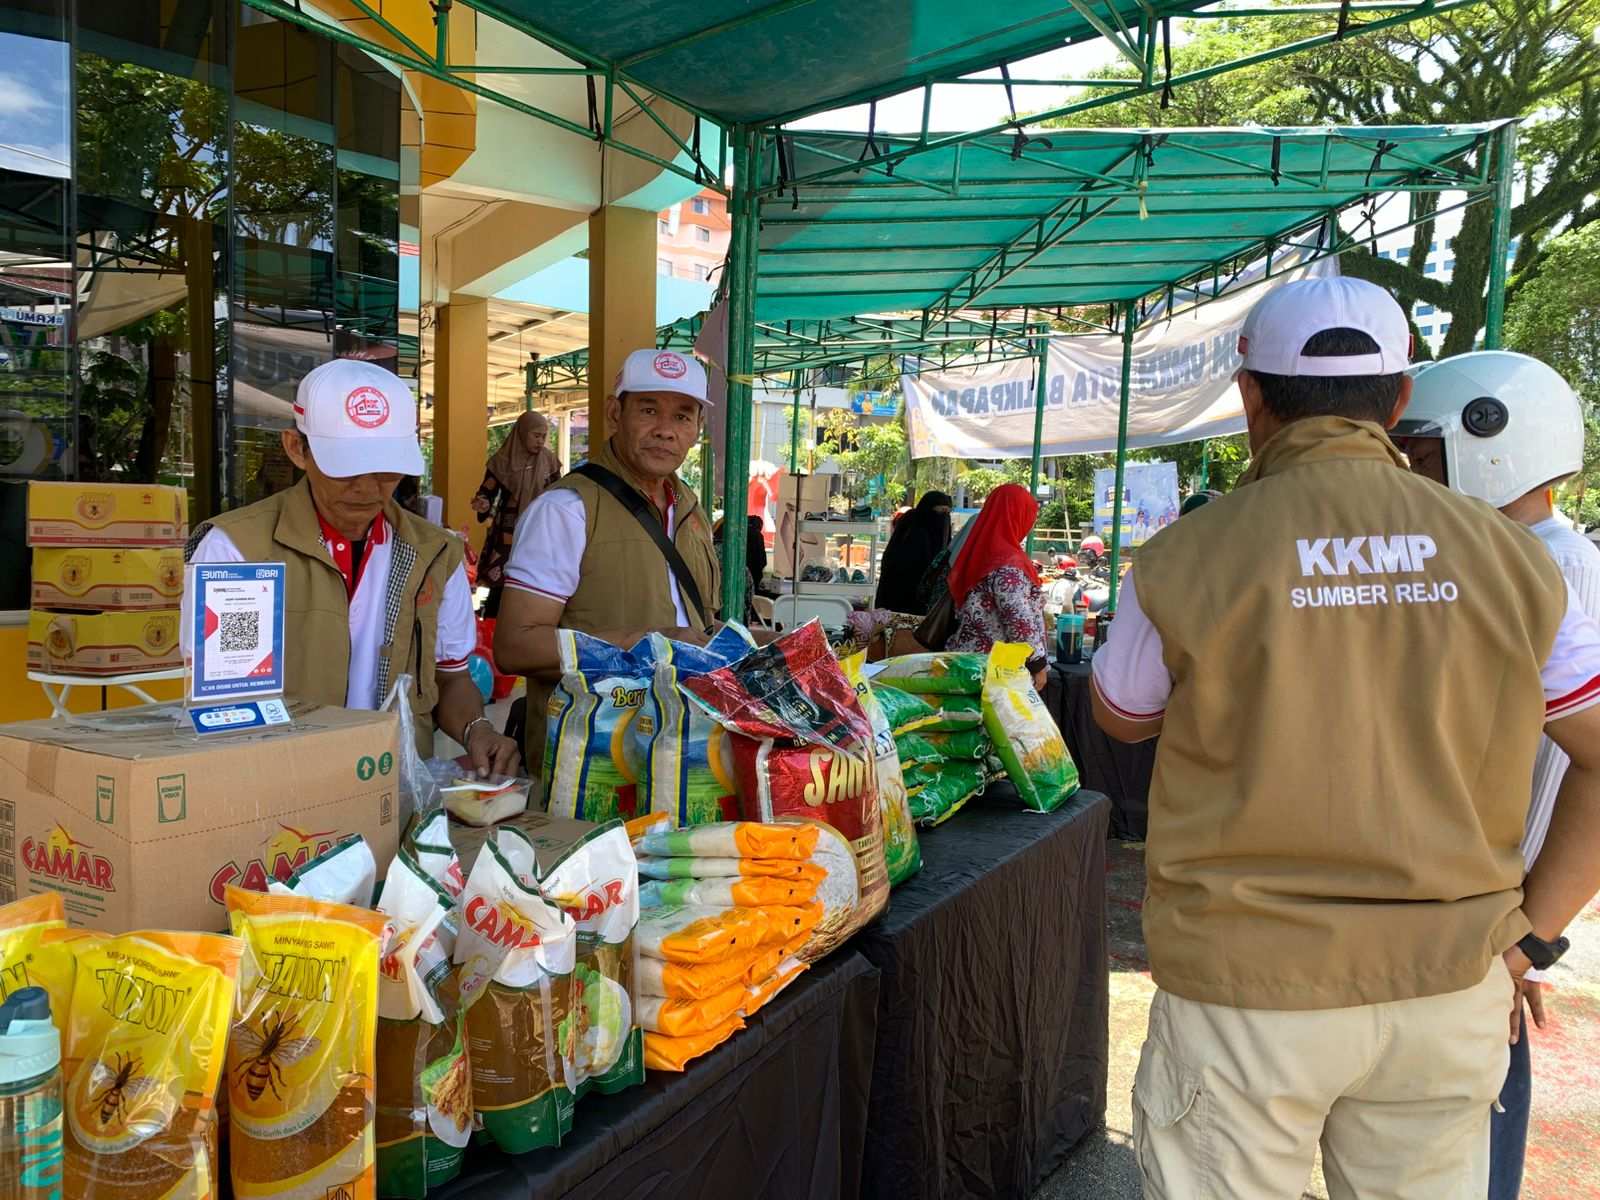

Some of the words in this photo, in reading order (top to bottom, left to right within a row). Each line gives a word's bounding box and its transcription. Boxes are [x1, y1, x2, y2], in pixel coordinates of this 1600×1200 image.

[1296, 535, 1437, 576] KKMP
[1291, 584, 1388, 608] SUMBER
[1394, 581, 1458, 604] REJO
[20, 836, 116, 893] CAMAR
[209, 834, 356, 905] CAM
